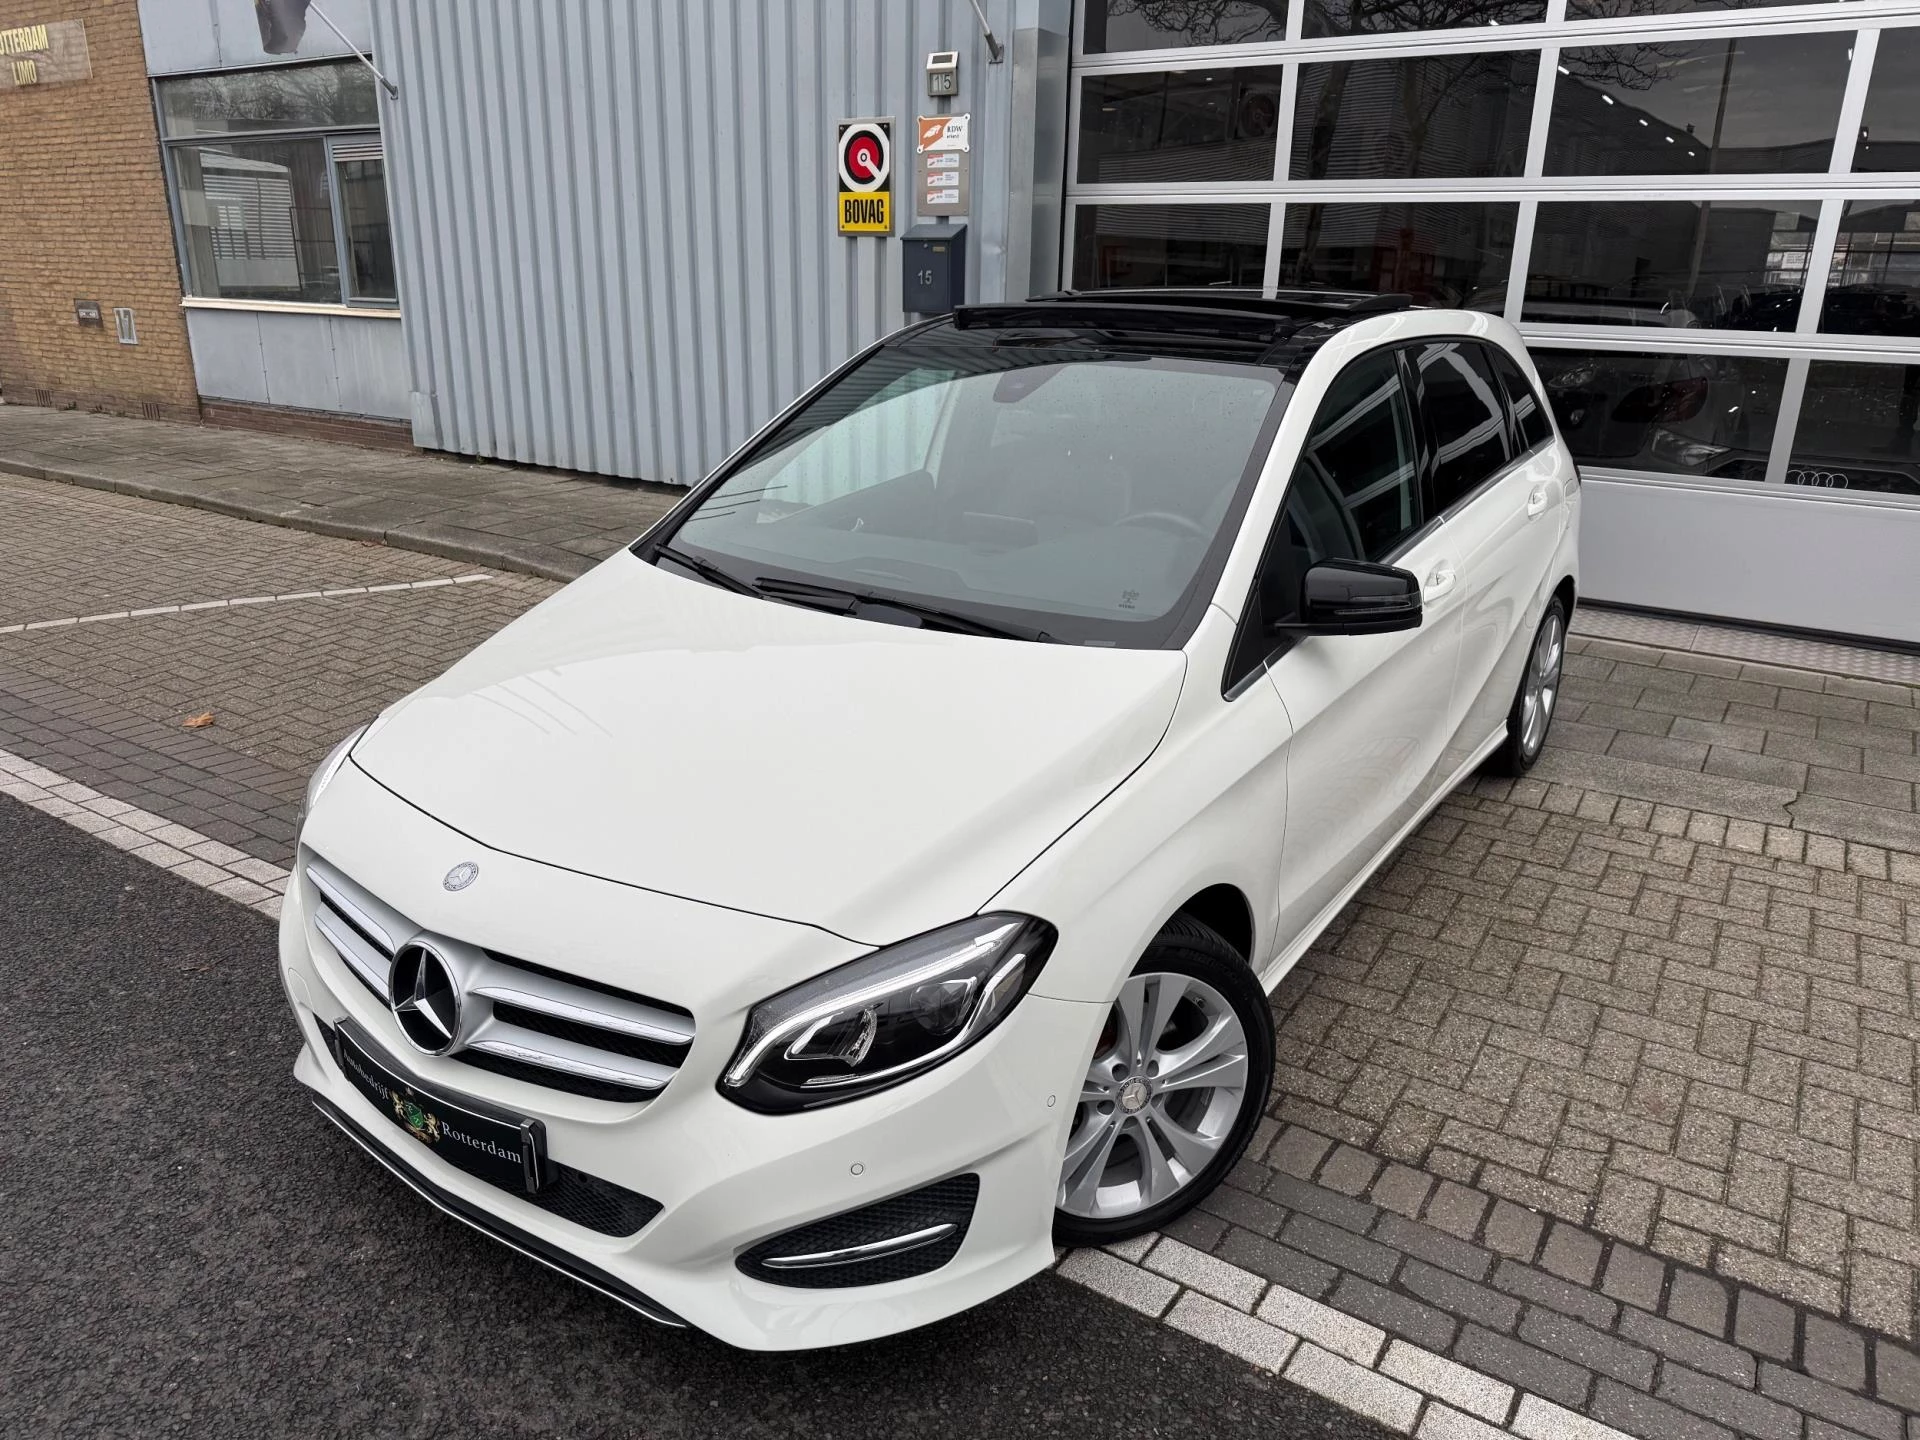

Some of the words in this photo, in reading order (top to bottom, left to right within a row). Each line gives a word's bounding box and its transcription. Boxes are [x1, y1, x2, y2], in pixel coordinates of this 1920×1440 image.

[11, 60, 37, 86] LIMO
[934, 73, 952, 91] 15
[844, 199, 884, 224] BOVAG
[917, 269, 932, 285] 15
[343, 1048, 389, 1100] Autobedrijf
[441, 1121, 522, 1164] Rotterdam
